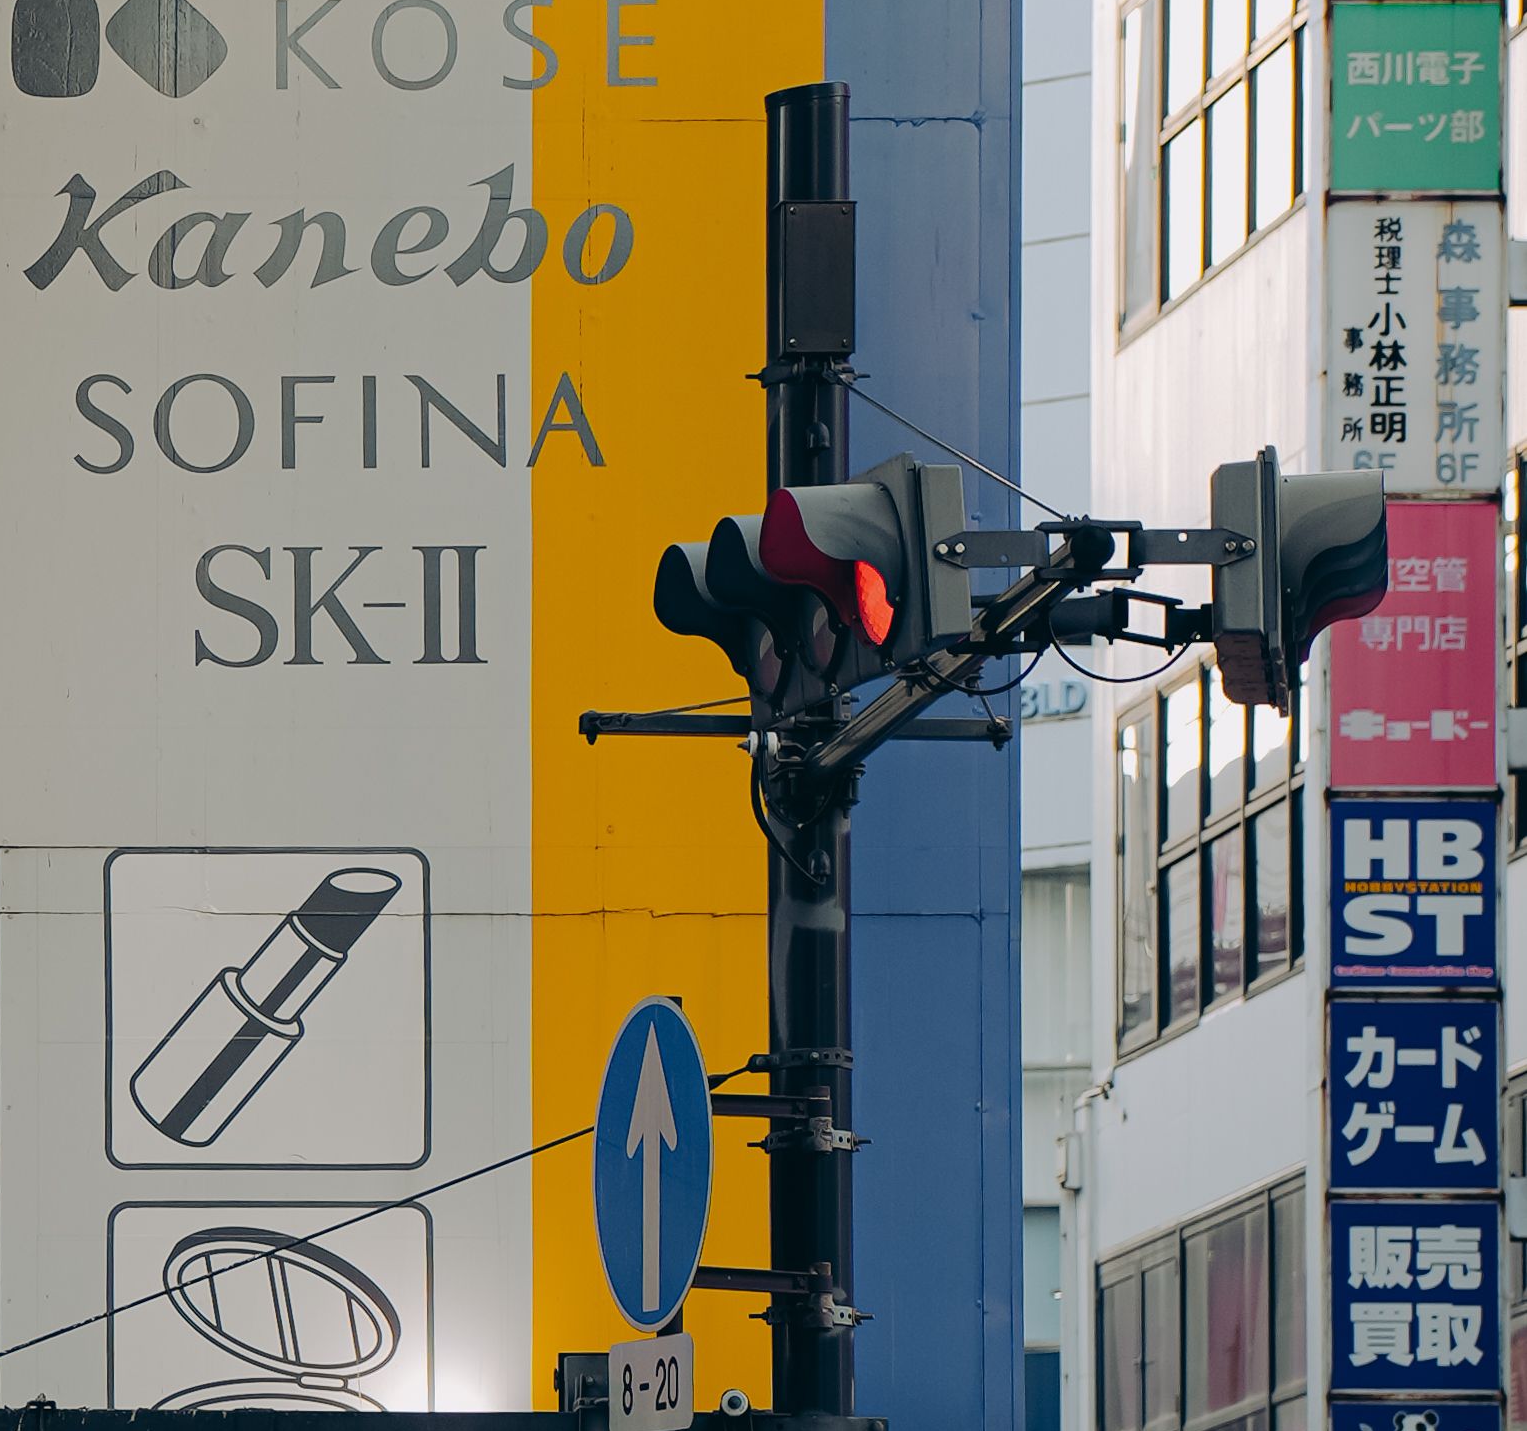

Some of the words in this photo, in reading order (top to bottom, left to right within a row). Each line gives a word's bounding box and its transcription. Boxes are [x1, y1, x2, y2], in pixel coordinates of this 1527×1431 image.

[1347, 51, 1485, 86] 西川電子
[1347, 110, 1485, 143] パーツ部
[22, 161, 635, 293] Kanebo
[1434, 219, 1482, 444] 森事務所
[73, 370, 607, 475] SOFINA
[194, 543, 489, 668] SK-II
[1387, 556, 1468, 594] 空管
[1358, 616, 1468, 652] 専門店
[1343, 819, 1484, 880] HB
[1345, 882, 1483, 893] HOBBYSTATION
[1343, 894, 1483, 956] ST
[1344, 1026, 1483, 1089] カード
[1342, 1102, 1486, 1166] ゲーム
[1348, 1225, 1482, 1289] 販売
[1349, 1303, 1482, 1367] 買取
